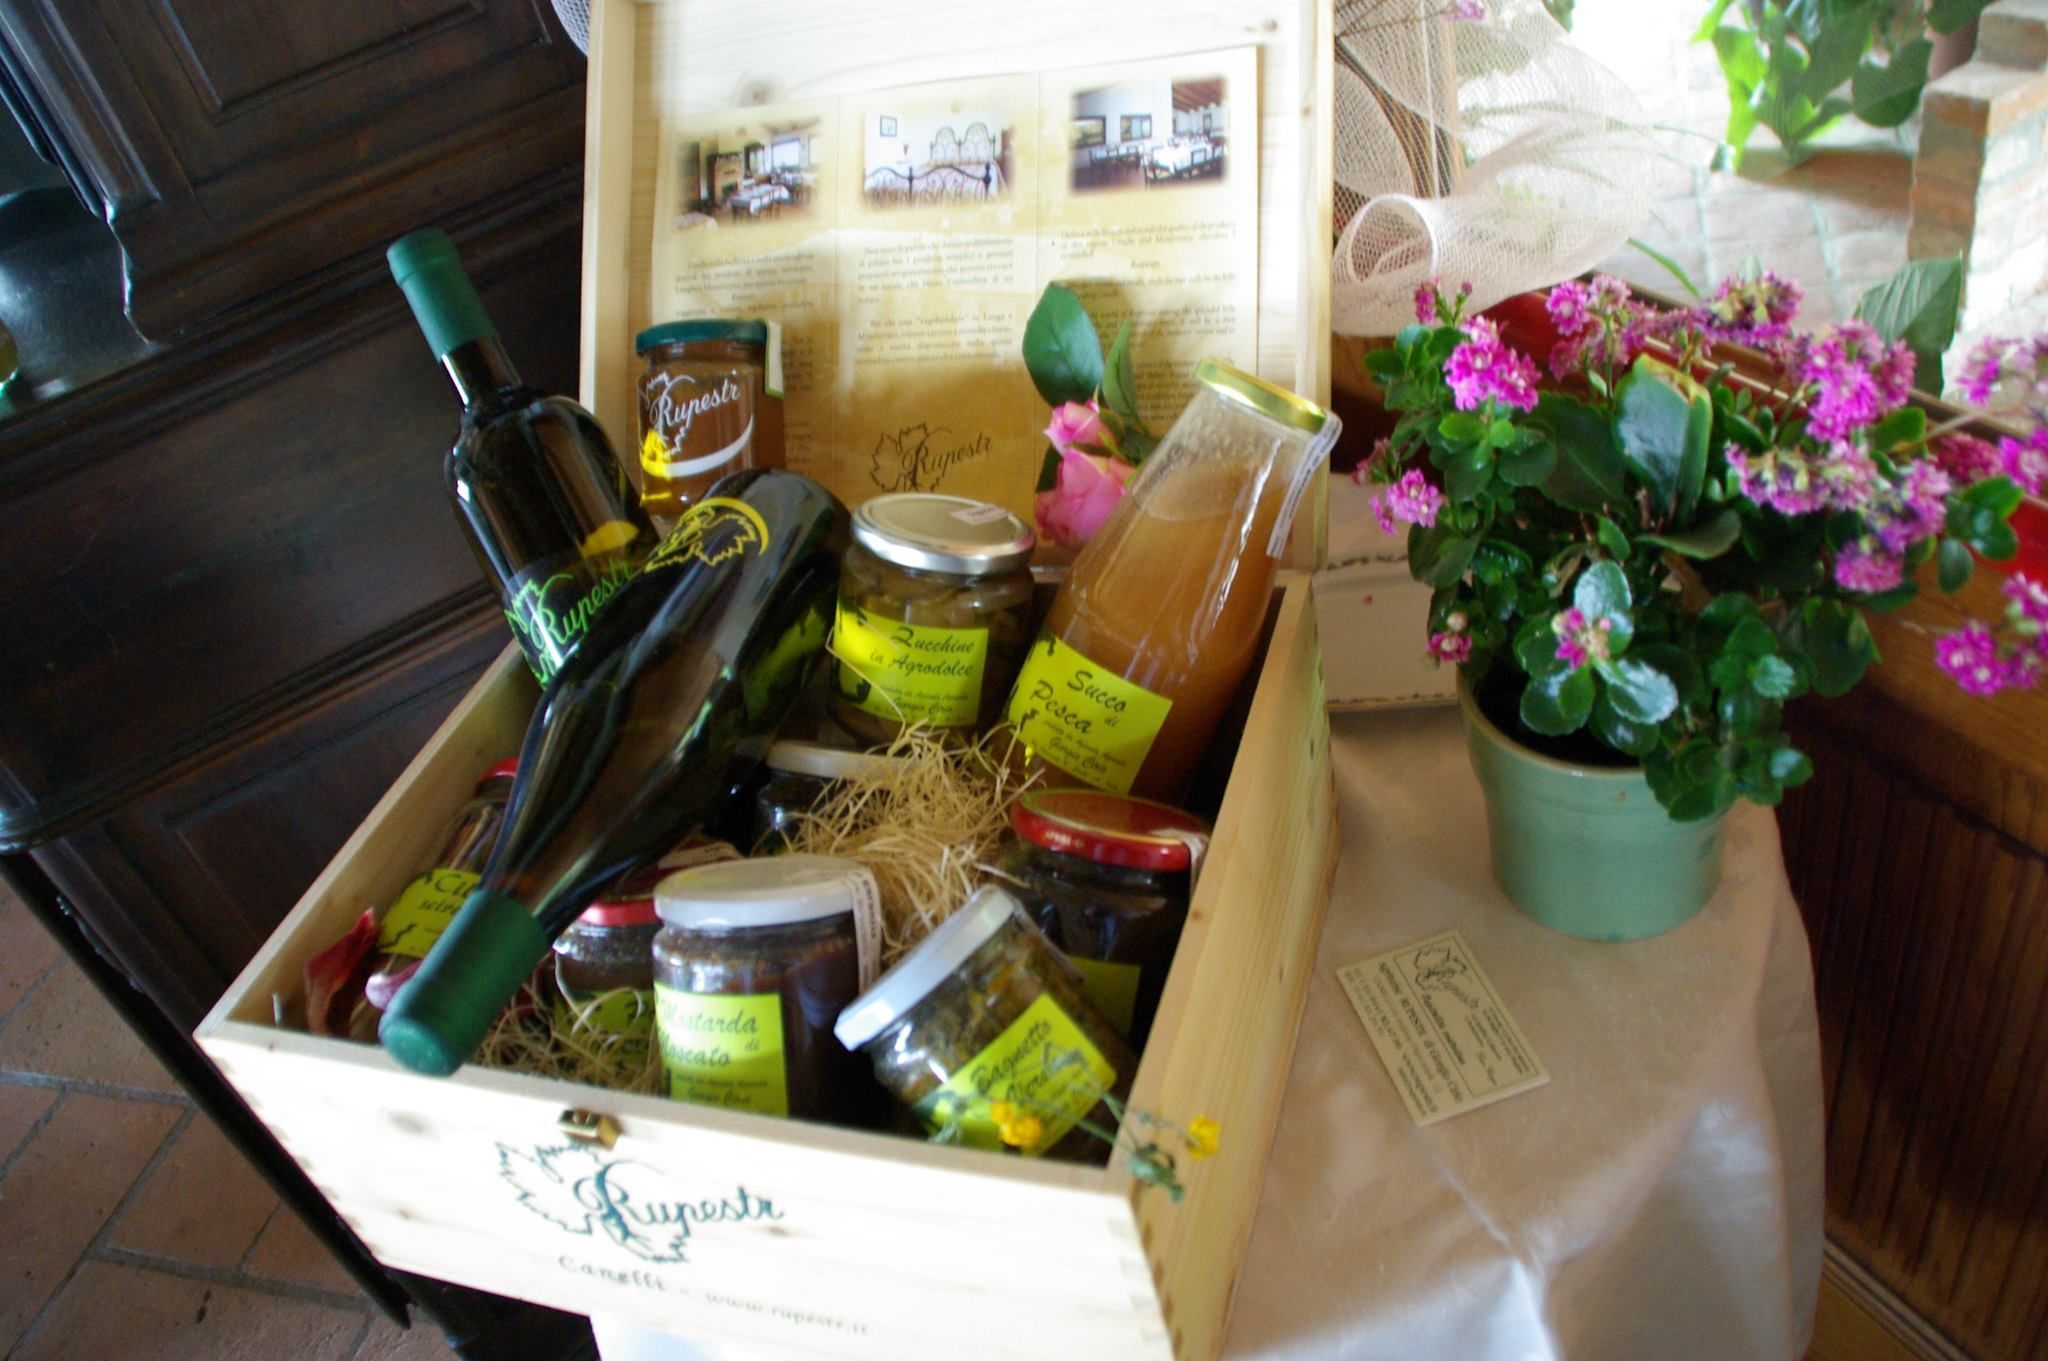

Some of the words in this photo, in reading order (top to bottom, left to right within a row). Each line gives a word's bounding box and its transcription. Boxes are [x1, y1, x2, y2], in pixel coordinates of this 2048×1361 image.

[650, 375, 741, 437] Rupestr
[902, 427, 991, 487] Rupestr
[890, 626, 975, 652] Zucchine
[888, 652, 974, 677] Agrodolce
[1029, 679, 1092, 734] Pesca
[1067, 669, 1128, 713] Succo
[572, 1158, 785, 1242] Rupestr
[558, 1254, 668, 1293] Canelli
